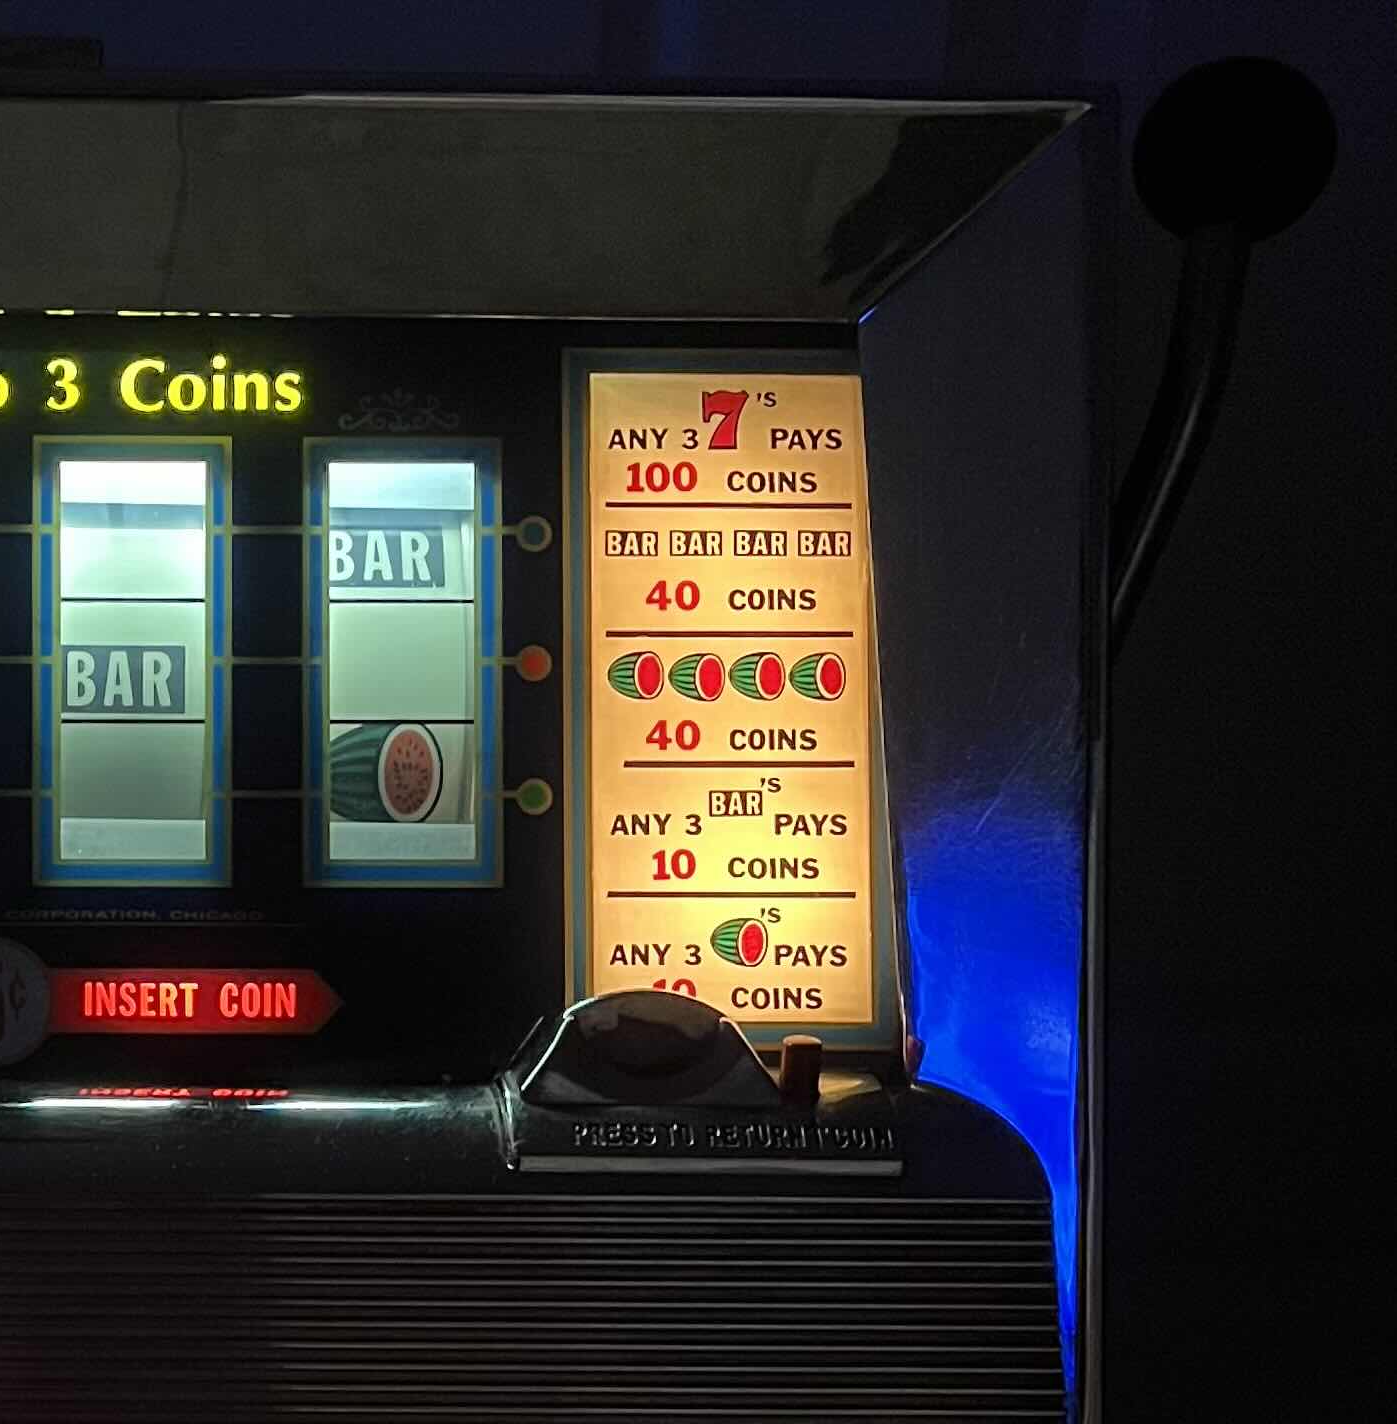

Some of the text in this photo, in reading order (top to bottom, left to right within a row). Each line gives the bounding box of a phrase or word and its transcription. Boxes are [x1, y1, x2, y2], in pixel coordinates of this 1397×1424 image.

[46, 359, 81, 412] 3
[120, 355, 303, 412] Coins
[608, 428, 669, 450] ANY
[681, 428, 699, 450] 3
[769, 428, 843, 450] PAYS
[625, 461, 818, 494] 100 COINS
[328, 528, 432, 584] BAR
[607, 532, 850, 556] BAR BAR BAR BAR
[644, 580, 817, 612] 40 COINS
[66, 649, 172, 708] BAR
[645, 719, 818, 752] 40 COINS
[610, 813, 672, 836] ANY
[684, 814, 702, 836] 3
[773, 813, 848, 836] PAYS
[652, 849, 820, 881] 10 COINS
[609, 944, 848, 967] ANY 3 PAYS
[84, 980, 297, 1019] INSERT COIN
[730, 987, 824, 1010] COINS
